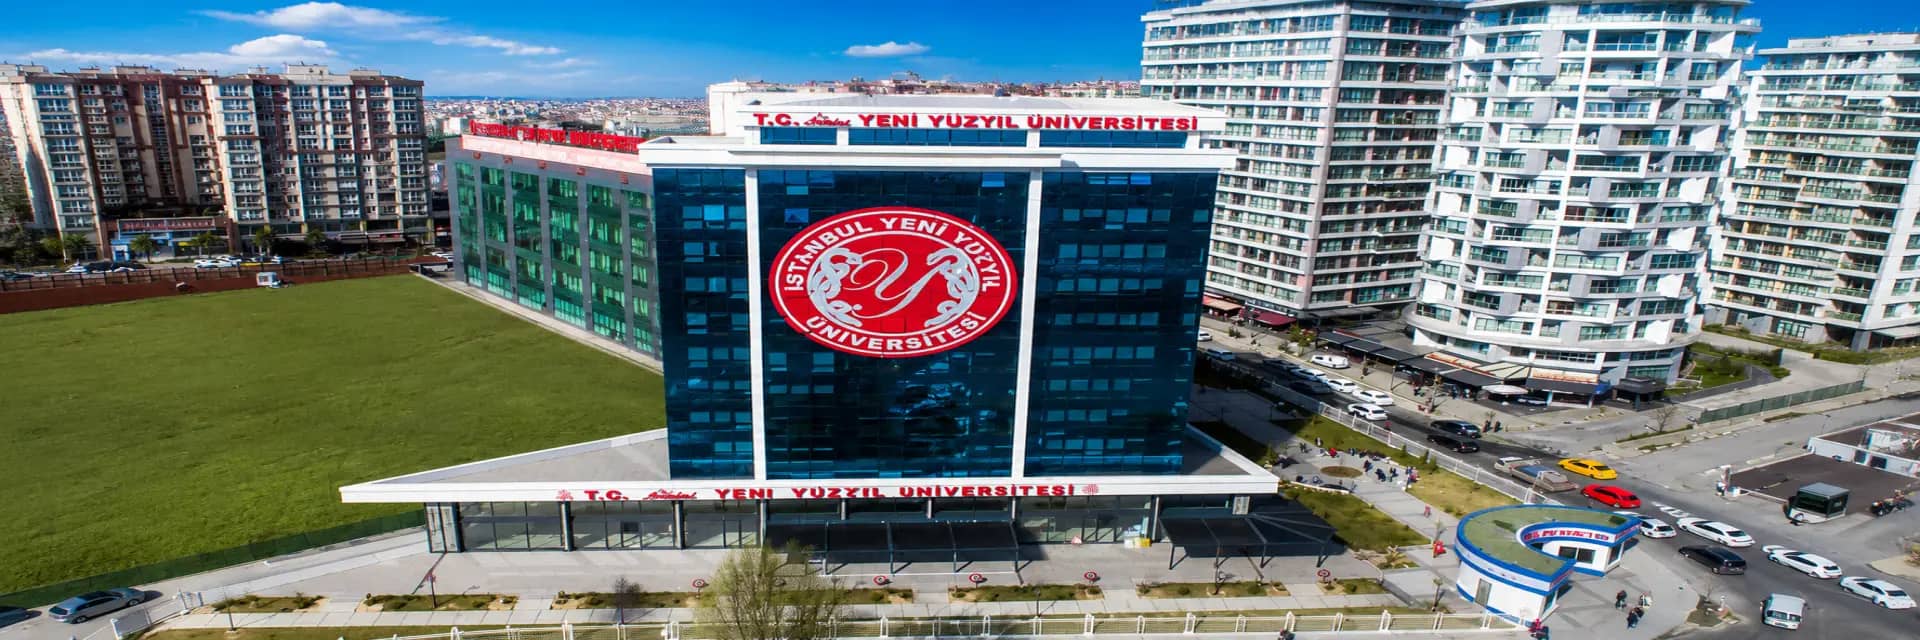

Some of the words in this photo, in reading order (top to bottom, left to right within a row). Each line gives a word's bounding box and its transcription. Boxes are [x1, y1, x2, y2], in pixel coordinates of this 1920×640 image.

[753, 113, 800, 126] T.C.
[858, 112, 918, 127] YENİ
[927, 113, 1018, 129] YÜZYIL
[1026, 114, 1198, 131] ÜNİVERSİTESİ
[880, 216, 950, 238] YENİ
[584, 489, 629, 501] T.C.
